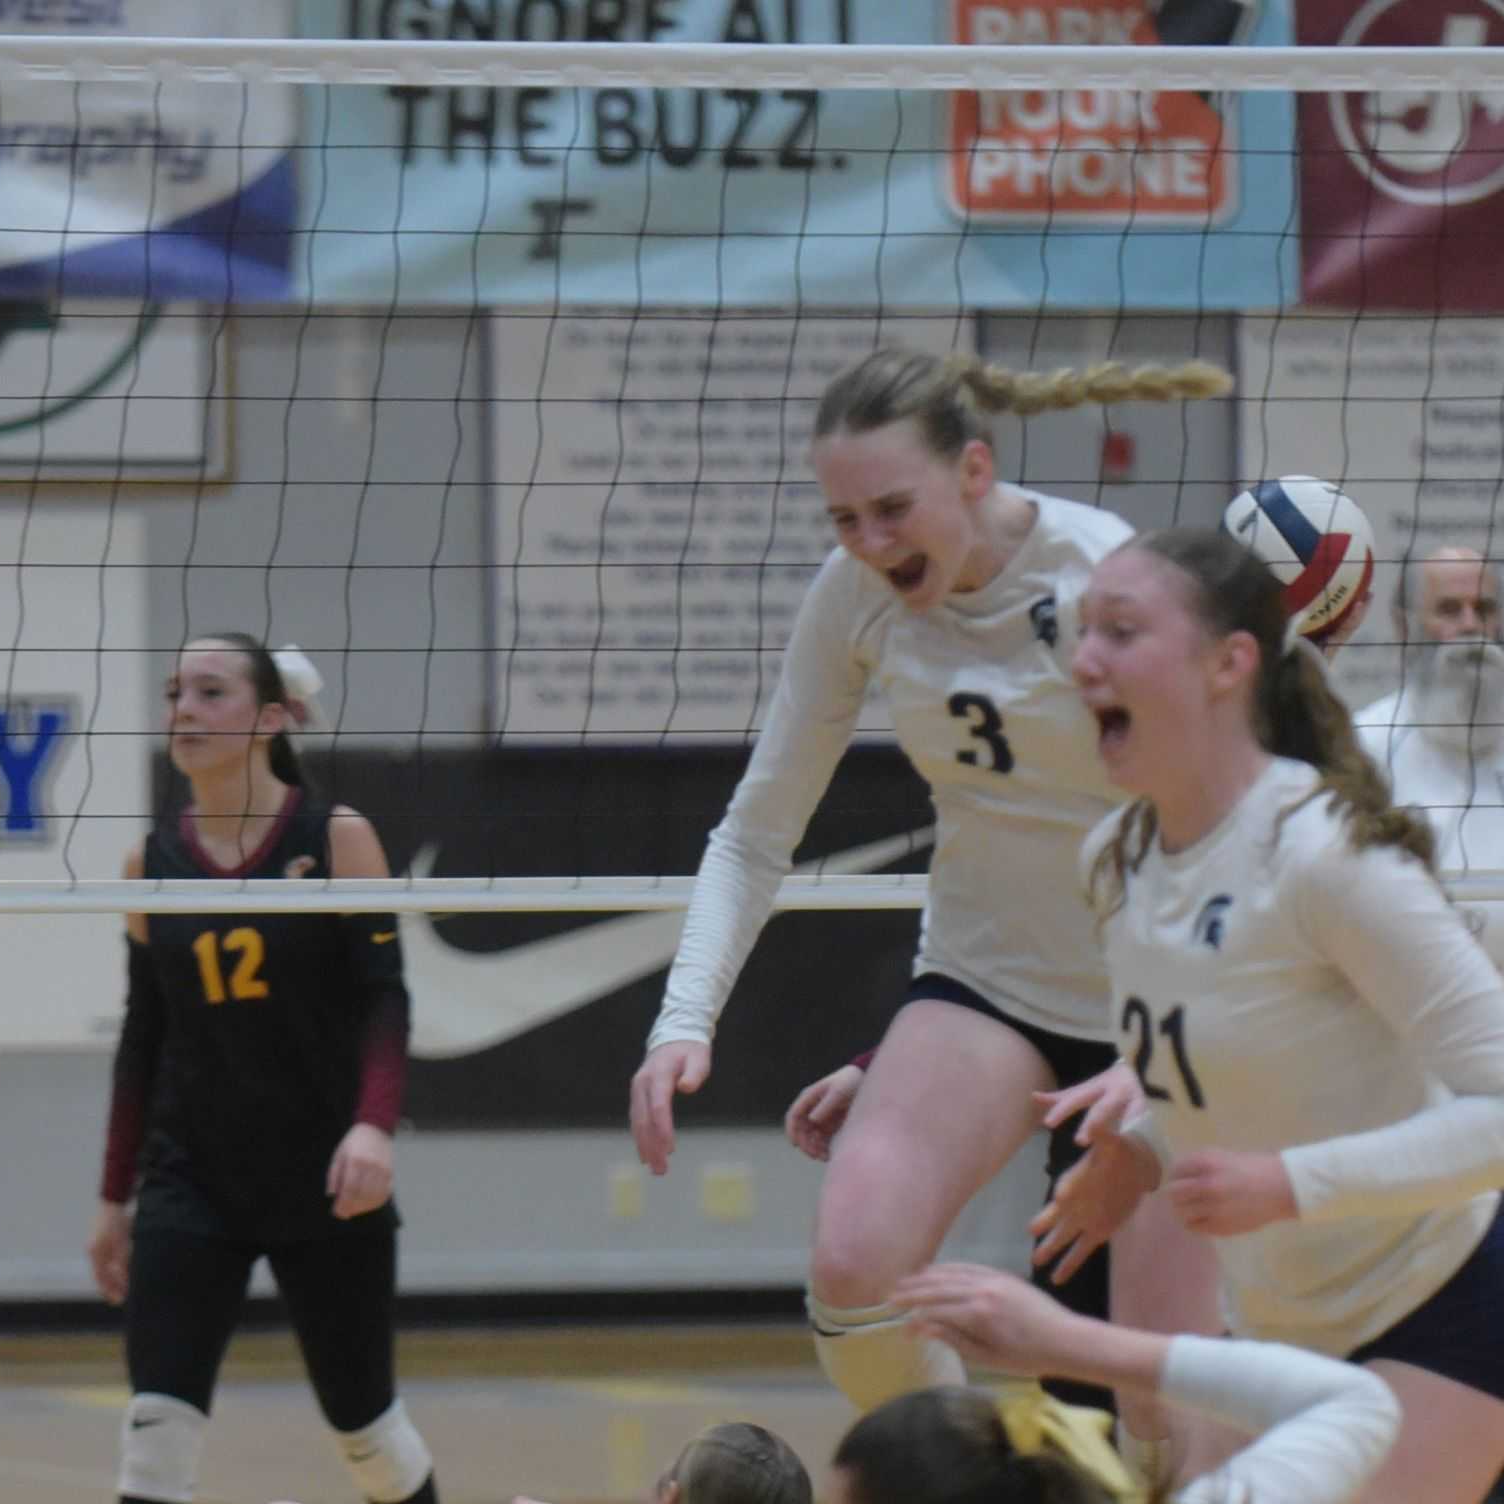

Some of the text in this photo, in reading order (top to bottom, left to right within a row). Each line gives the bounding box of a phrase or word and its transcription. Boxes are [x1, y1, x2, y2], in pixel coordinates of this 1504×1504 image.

[389, 84, 850, 169] THE BUZZ.
[969, 138, 1209, 196] PHONE
[946, 691, 1013, 775] 3
[192, 927, 270, 1004] 12
[1120, 995, 1205, 1109] 21
